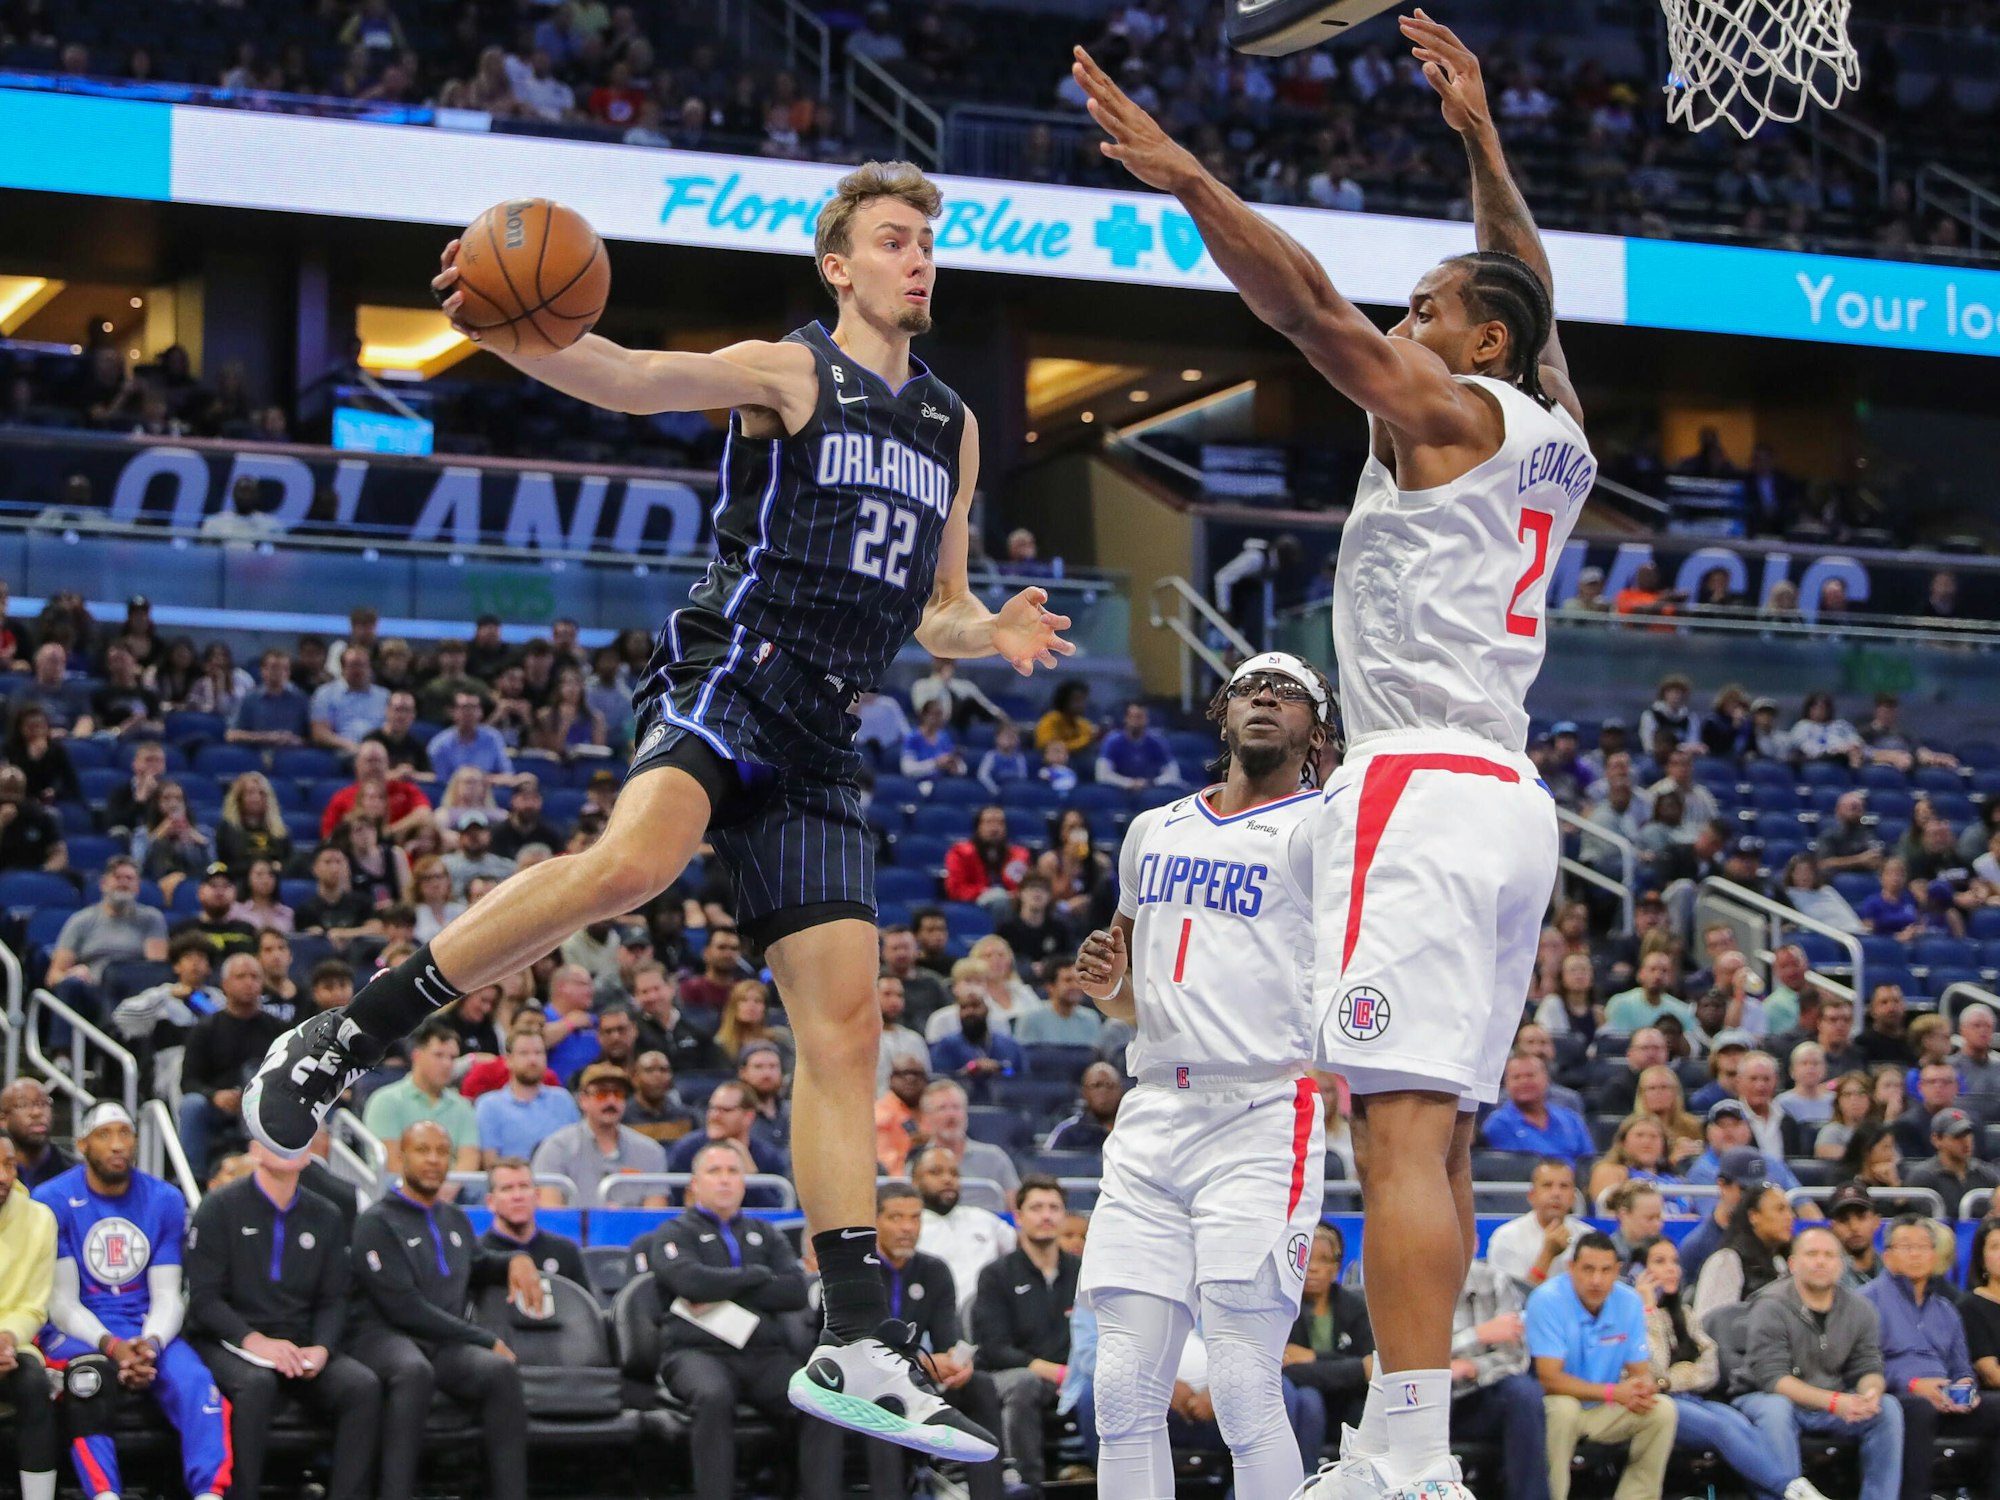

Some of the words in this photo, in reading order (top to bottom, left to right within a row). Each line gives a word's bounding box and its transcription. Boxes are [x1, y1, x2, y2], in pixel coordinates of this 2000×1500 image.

[659, 173, 836, 234] Flori
[932, 198, 1070, 259] Blue
[1796, 270, 1928, 333] Your
[1945, 281, 2000, 341] lo
[831, 364, 845, 384] 6
[920, 401, 951, 427] Disney
[110, 446, 718, 560] ORLAND
[816, 432, 951, 521] ORLANDO
[850, 495, 919, 590] 22
[1506, 507, 1554, 638] 2
[1246, 819, 1279, 838] honey
[1138, 853, 1269, 918] CLIPPERS
[1173, 918, 1192, 983] 1
